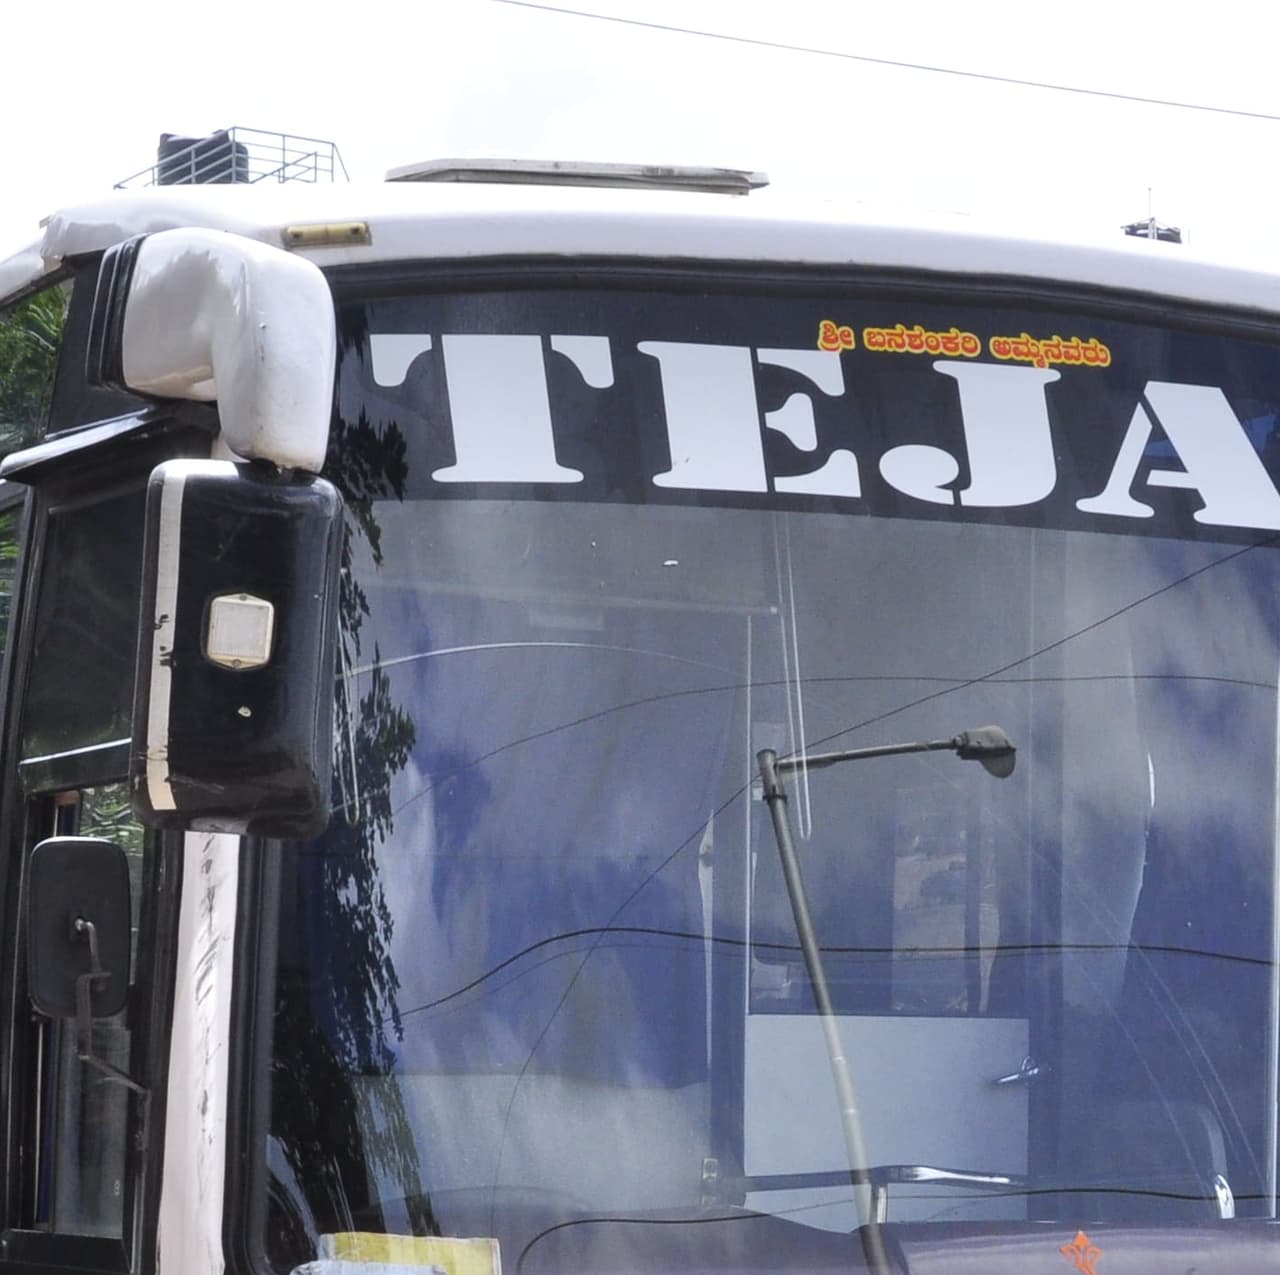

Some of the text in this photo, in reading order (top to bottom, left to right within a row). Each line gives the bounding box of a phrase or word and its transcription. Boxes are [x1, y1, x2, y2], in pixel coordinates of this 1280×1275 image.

[818, 320, 1111, 368] ಶ್ರೀ ಬನಶಂಕರಿ ಅಮ್ಮನವರು
